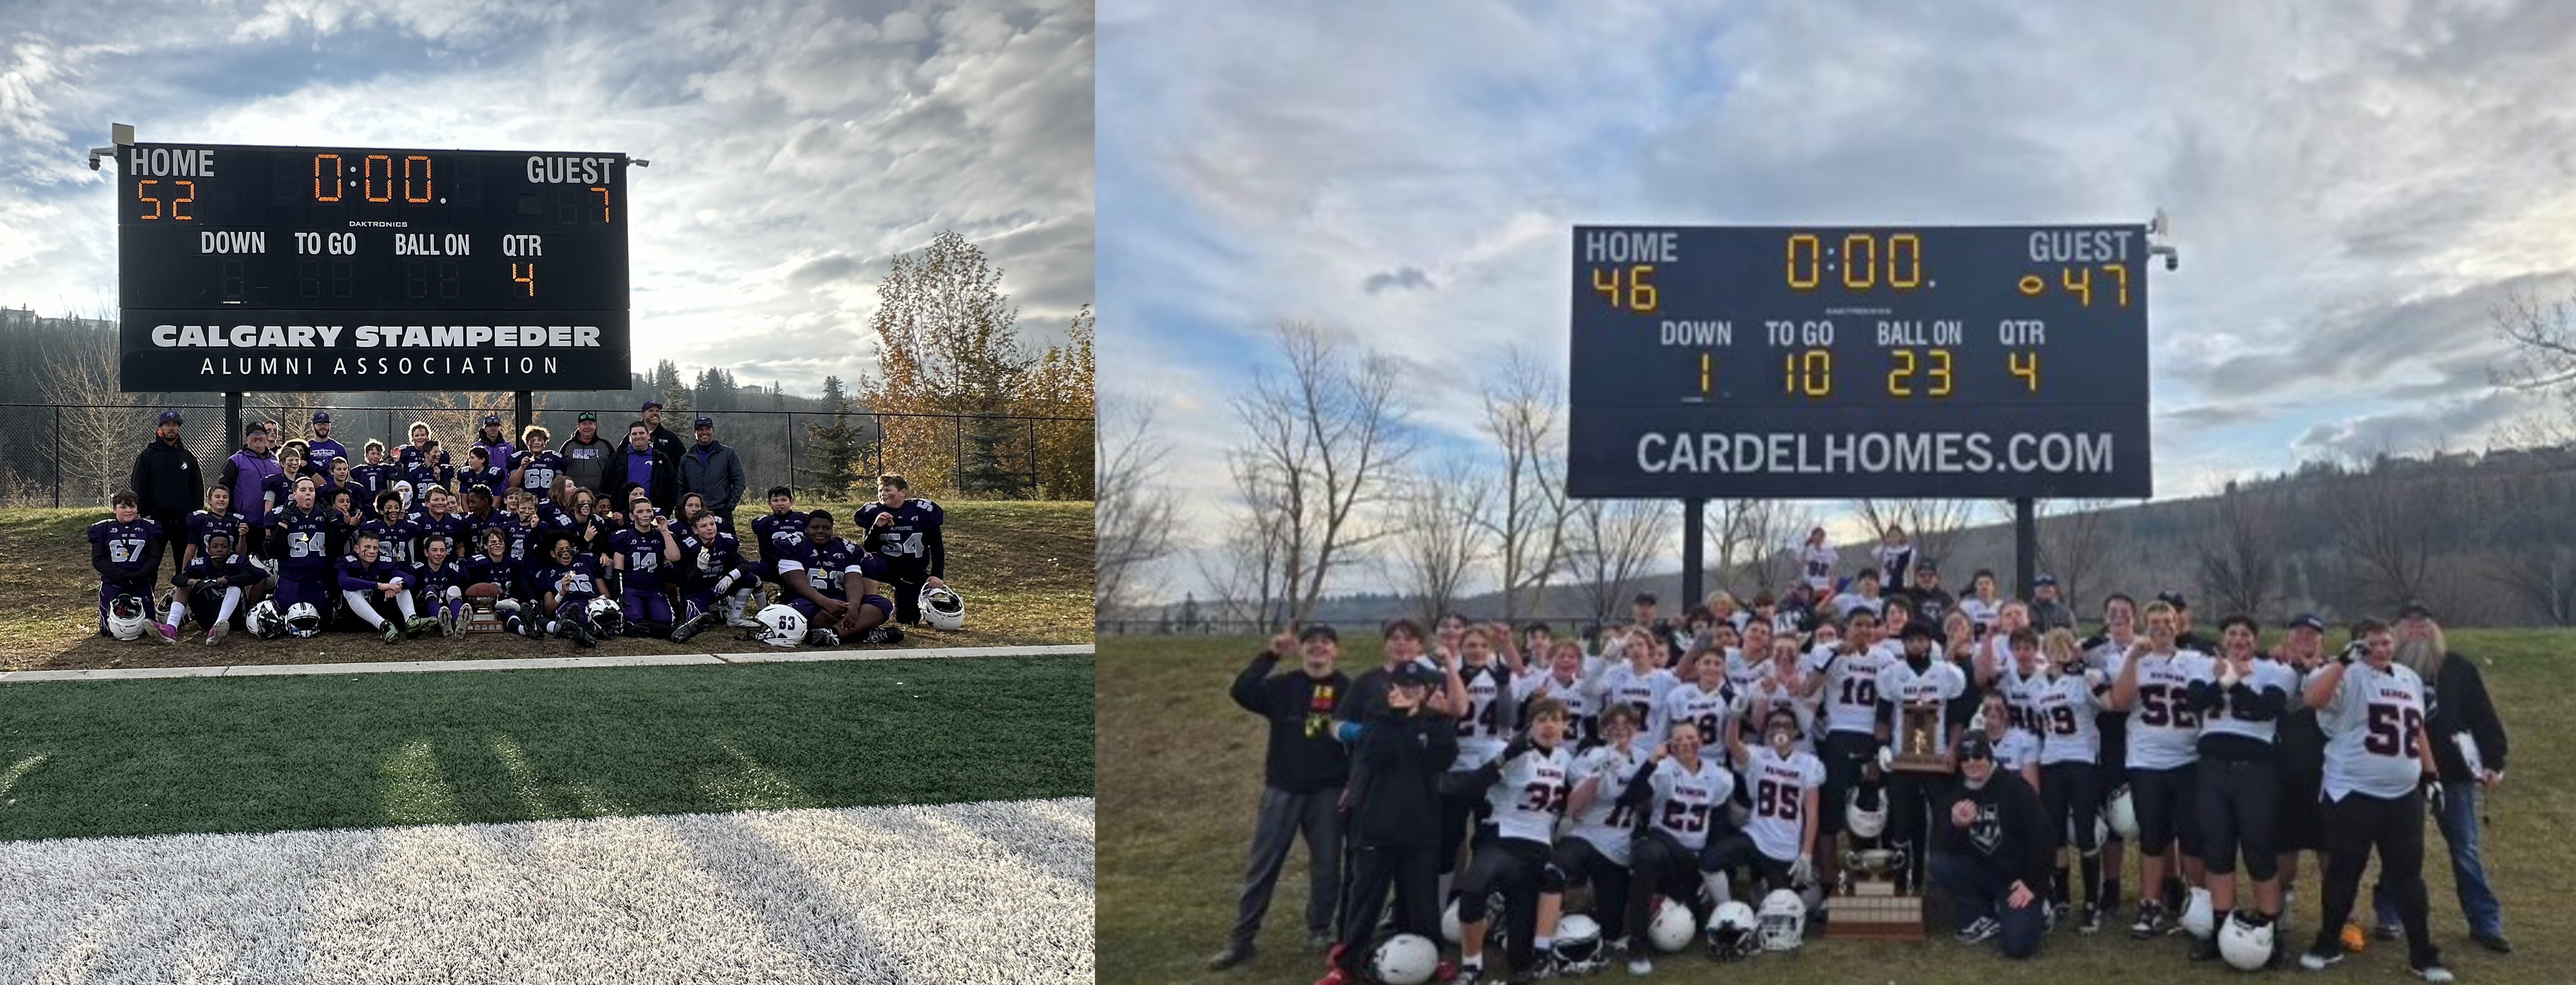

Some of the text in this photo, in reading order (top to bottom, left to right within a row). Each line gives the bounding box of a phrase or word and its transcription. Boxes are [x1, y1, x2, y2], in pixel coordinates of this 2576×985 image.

[131, 148, 214, 177] HOME
[527, 156, 615, 184] GUEST
[138, 180, 194, 220] 52
[590, 187, 610, 223] 7
[201, 231, 265, 254] DOWN
[294, 232, 356, 255] TO GO
[395, 233, 470, 256] BALL ON
[503, 234, 542, 257] QTR
[1586, 231, 1677, 262] HOME
[2030, 231, 2132, 262] GUEST
[512, 263, 534, 297] 4
[1593, 266, 1657, 311] 46
[2062, 265, 2127, 307] 47
[151, 324, 601, 348] CALGARY STAMPEDER
[1661, 321, 1731, 346] DOWN
[1766, 321, 1834, 346] TO GO
[1878, 321, 1962, 346] BALL ON
[1999, 320, 2045, 345] QTR
[200, 357, 557, 375] ALUMNI ASSOCIATION
[1701, 353, 1710, 392] 1
[1786, 351, 1831, 396] 10
[1888, 351, 1951, 395] 23
[2009, 352, 2037, 391] 4
[1637, 432, 2113, 473] CARDELHOMES.COM
[369, 476, 376, 491] 1
[524, 469, 554, 489] 68
[109, 539, 145, 562] 67
[879, 532, 924, 558] 54
[631, 552, 657, 572] 14
[779, 615, 795, 630] 63
[1839, 677, 1876, 707] 10
[2364, 703, 2422, 759] 58
[1758, 780, 1799, 820] 85
